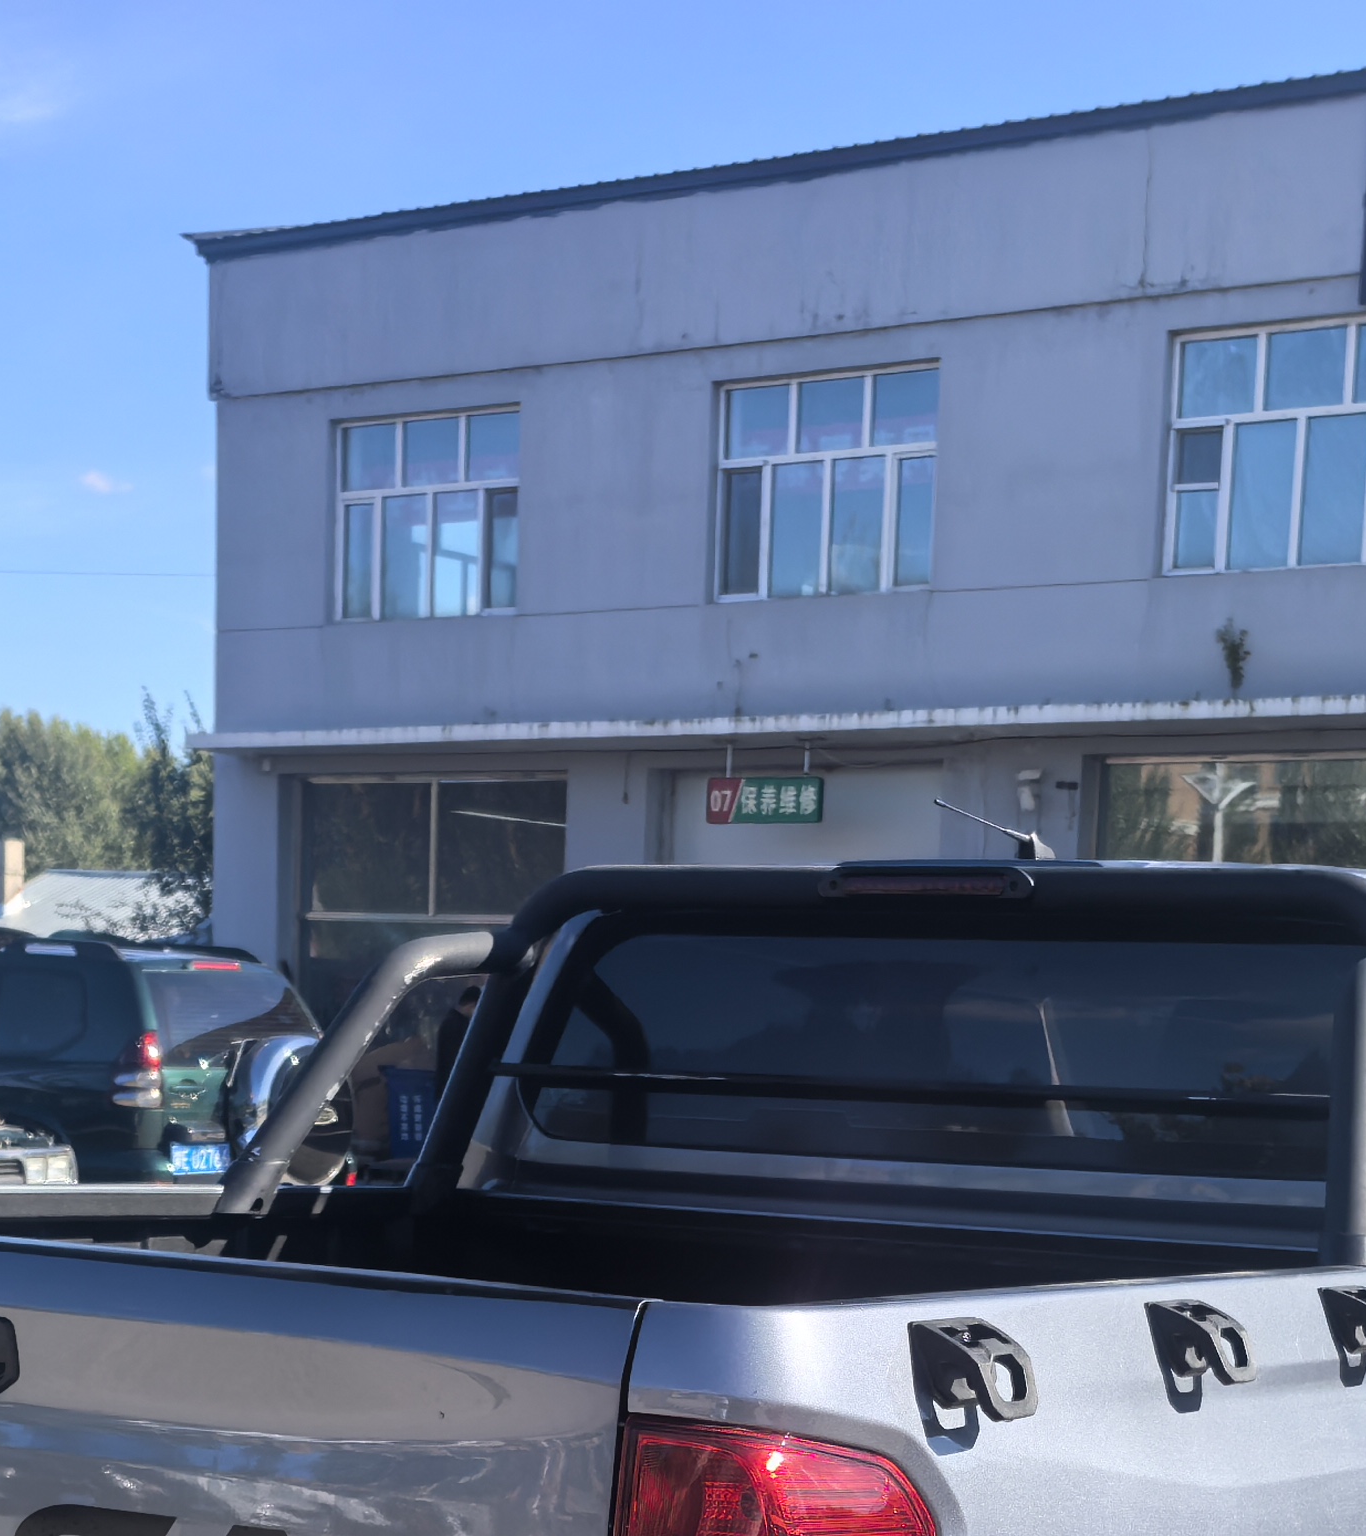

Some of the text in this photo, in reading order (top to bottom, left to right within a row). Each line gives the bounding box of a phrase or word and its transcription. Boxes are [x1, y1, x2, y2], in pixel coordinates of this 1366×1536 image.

[710, 785, 817, 815] 07 保养维修
